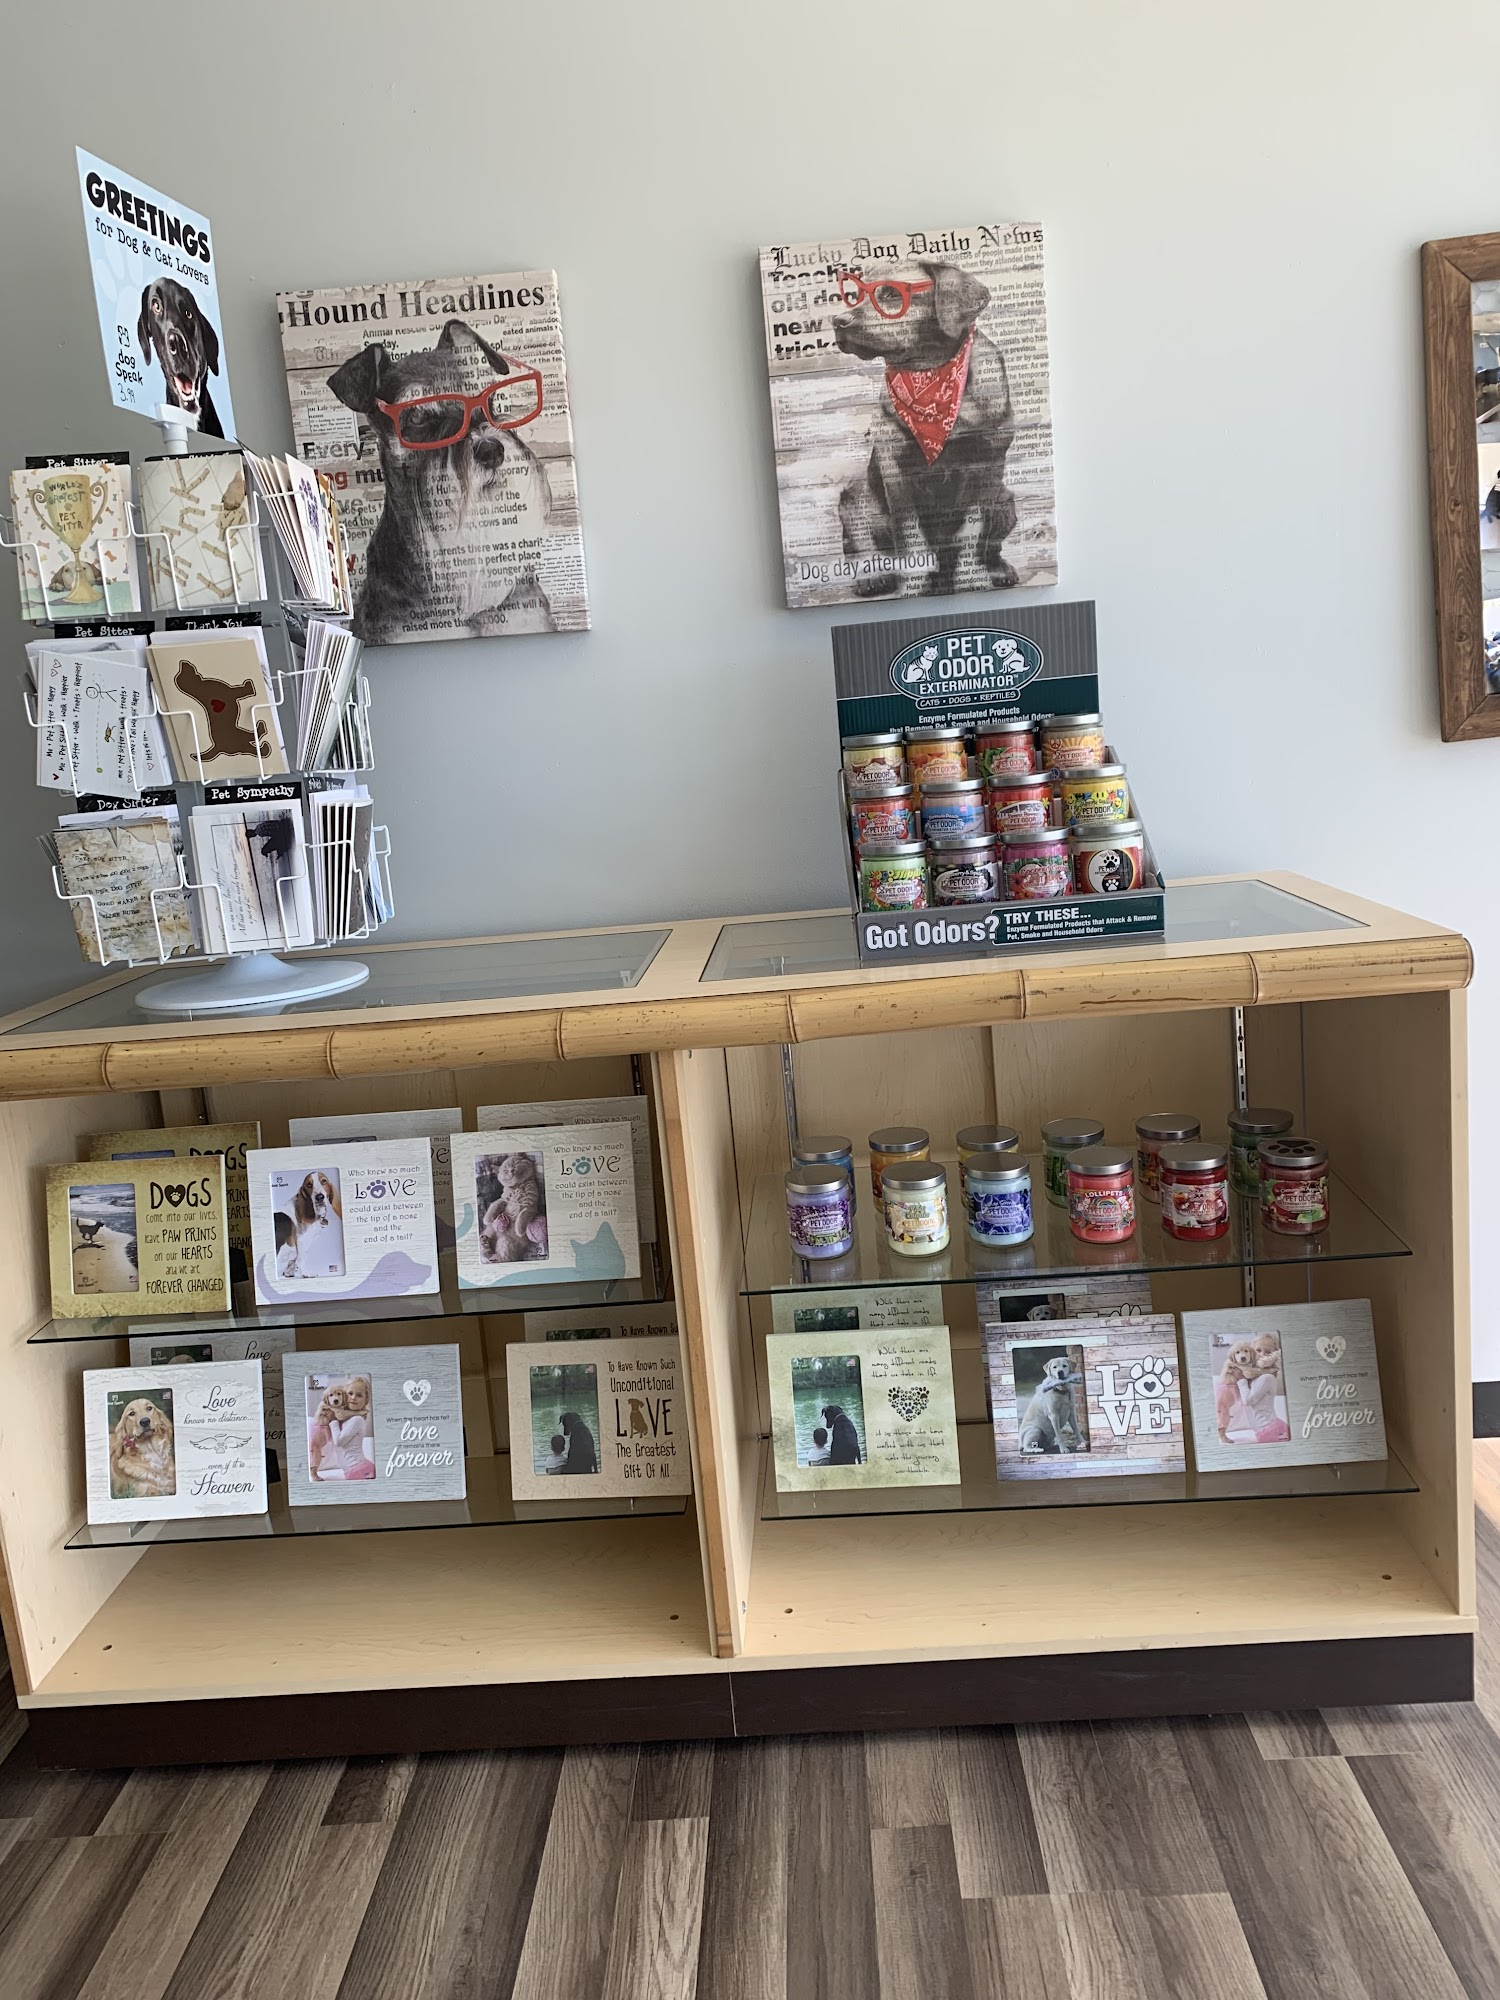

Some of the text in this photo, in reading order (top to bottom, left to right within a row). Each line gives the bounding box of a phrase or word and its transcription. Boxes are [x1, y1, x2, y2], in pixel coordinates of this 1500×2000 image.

[86, 172, 210, 263] GREETINGS
[95, 217, 209, 285] for Dog & Cat Lovers
[770, 225, 1043, 272] Lucky Dog Daily News
[285, 283, 545, 327] Hound Headlines
[771, 292, 808, 313] old
[773, 319, 823, 338] new
[118, 349, 136, 369] dog
[303, 442, 365, 461] Every
[46, 459, 67, 469] Pet
[59, 511, 76, 522] PET
[485, 551, 542, 565] perfect place
[800, 551, 935, 583] Dog day afternoon
[75, 625, 135, 638] Pet Sitter
[947, 635, 986, 658] PET
[938, 655, 995, 679] ODOR
[919, 691, 1016, 708] CATS DOGS REPTILES
[918, 706, 1021, 725] Enzyme Formulated Products
[992, 714, 1030, 724] Household
[211, 786, 295, 800] Pet Sympathy
[97, 799, 119, 811] Dog
[1004, 907, 1092, 925] TRY THESE...
[1006, 914, 1158, 933] Enzyme Formulated Products that Attack & Remove
[866, 915, 1000, 950] Got Odors?
[1007, 932, 1020, 940] Pet,
[1020, 931, 1041, 940] Smoke
[1054, 927, 1085, 936] Household
[553, 1146, 571, 1154] Who
[573, 1145, 591, 1153] knew
[604, 1142, 625, 1150] much
[347, 1169, 366, 1177] Who
[367, 1168, 387, 1176] knew
[400, 1165, 421, 1173] much
[555, 1179, 628, 1190] could exist between
[1085, 1190, 1124, 1198] LOLLIPETS
[349, 1202, 424, 1214] could exist between
[146, 1213, 163, 1223] come
[166, 1212, 181, 1222] into
[184, 1212, 196, 1221] our
[370, 1215, 381, 1223] tip
[383, 1213, 391, 1222] of
[145, 1226, 217, 1244] leave PAW PRINTS
[373, 1223, 402, 1232] and the
[364, 1235, 378, 1243] end
[380, 1234, 388, 1243] of
[396, 1233, 413, 1241] tail?
[154, 1245, 213, 1261] on our HEARTS
[166, 1265, 200, 1275] and we are
[146, 1278, 224, 1294] FOREVER CHANGED
[607, 1358, 676, 1373] To Have Known Such
[610, 1376, 675, 1393] Unconditional
[1316, 1378, 1358, 1400] love
[202, 1385, 237, 1412] Love
[183, 1413, 205, 1425] knows
[1302, 1406, 1376, 1438] forever
[400, 1420, 439, 1441] love
[615, 1441, 677, 1459] The Greatest
[385, 1446, 454, 1478] forever
[623, 1462, 670, 1479] Gift Of All
[190, 1471, 255, 1496] Heaven
